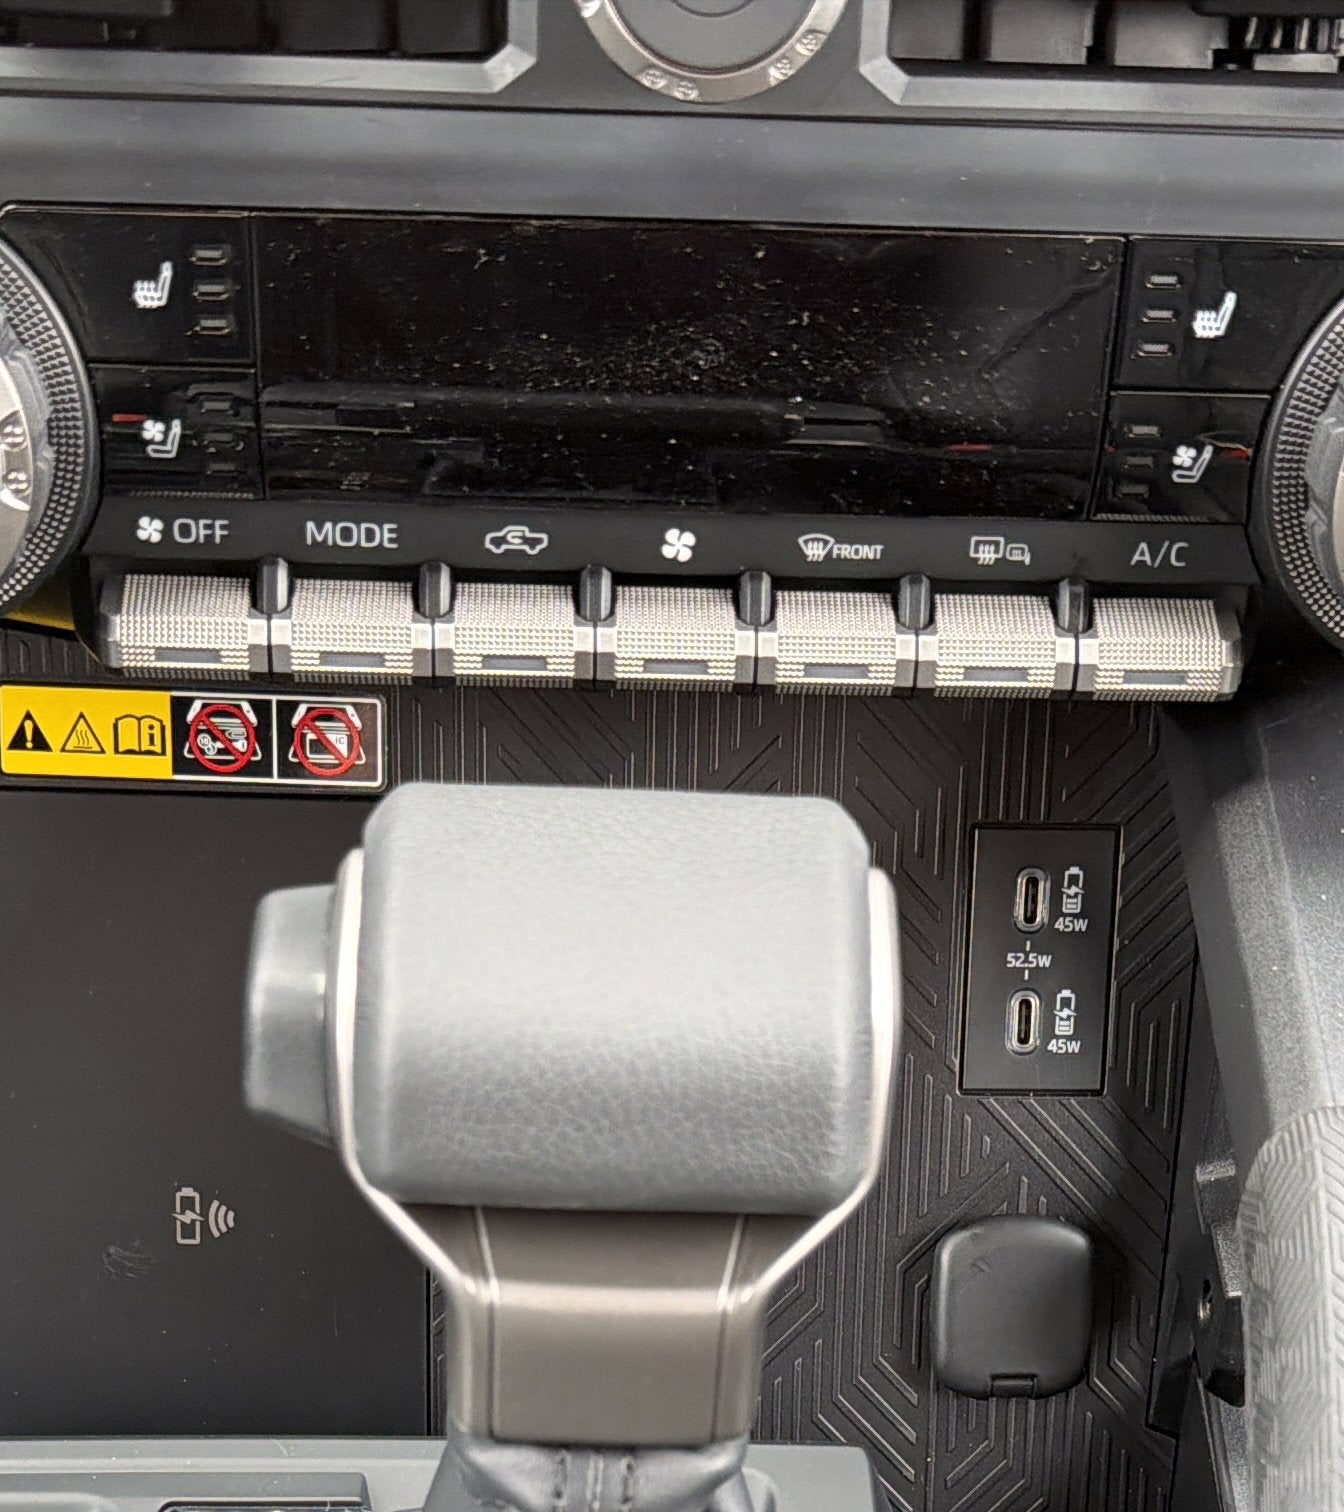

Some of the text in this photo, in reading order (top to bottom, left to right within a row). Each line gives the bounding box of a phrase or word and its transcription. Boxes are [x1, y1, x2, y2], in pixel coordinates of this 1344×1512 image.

[173, 518, 231, 545] OFF
[305, 519, 399, 548] MODE
[832, 543, 884, 561] FRONT
[1130, 541, 1190, 568] A/C
[1054, 917, 1088, 932] 45W
[1006, 953, 1052, 968] 52.5W
[1047, 1039, 1081, 1054] 45W
